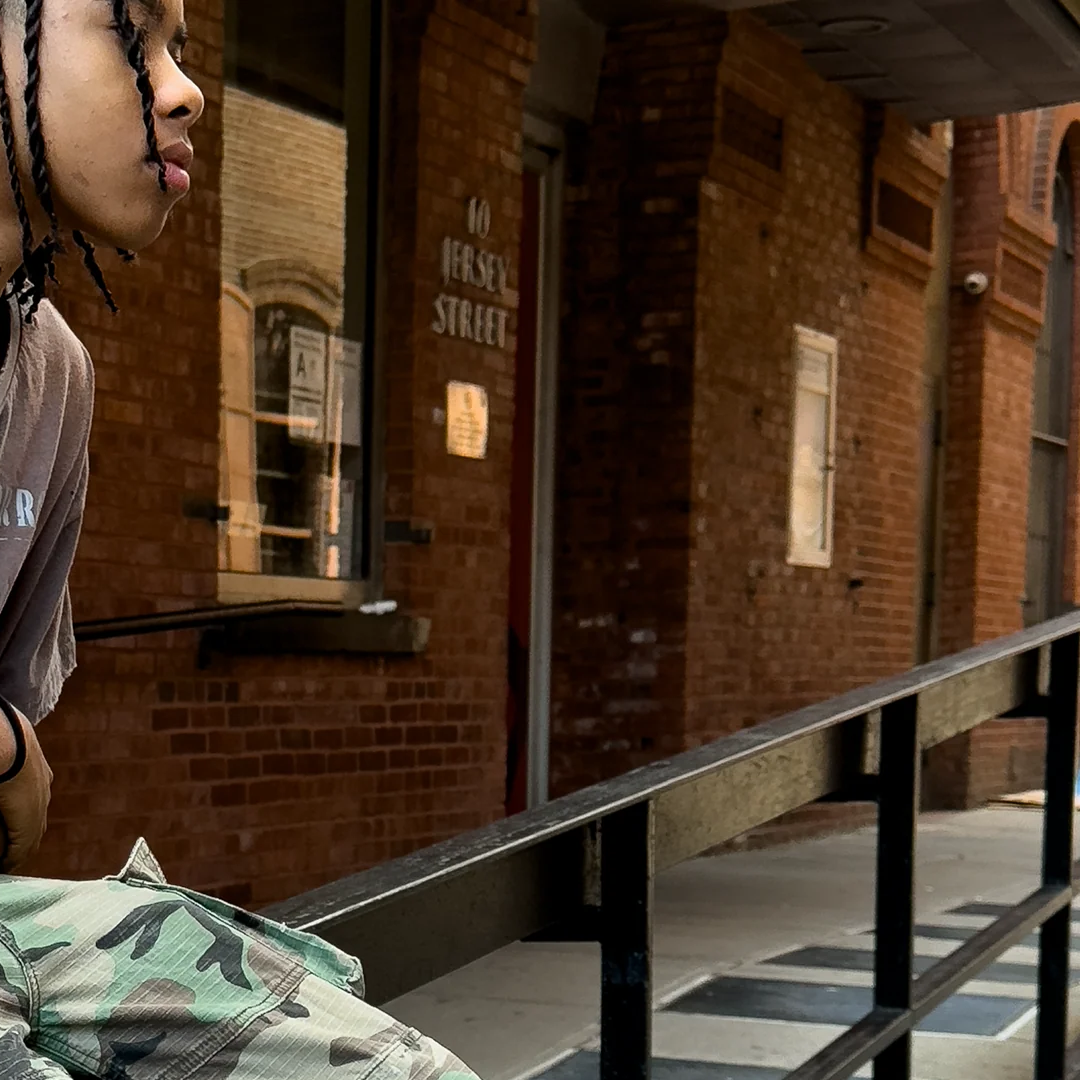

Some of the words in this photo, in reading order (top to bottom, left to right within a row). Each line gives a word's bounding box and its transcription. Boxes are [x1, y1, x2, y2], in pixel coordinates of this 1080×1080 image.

[467, 197, 492, 239] 10
[440, 236, 511, 295] JERSEY
[430, 293, 508, 348] STREET
